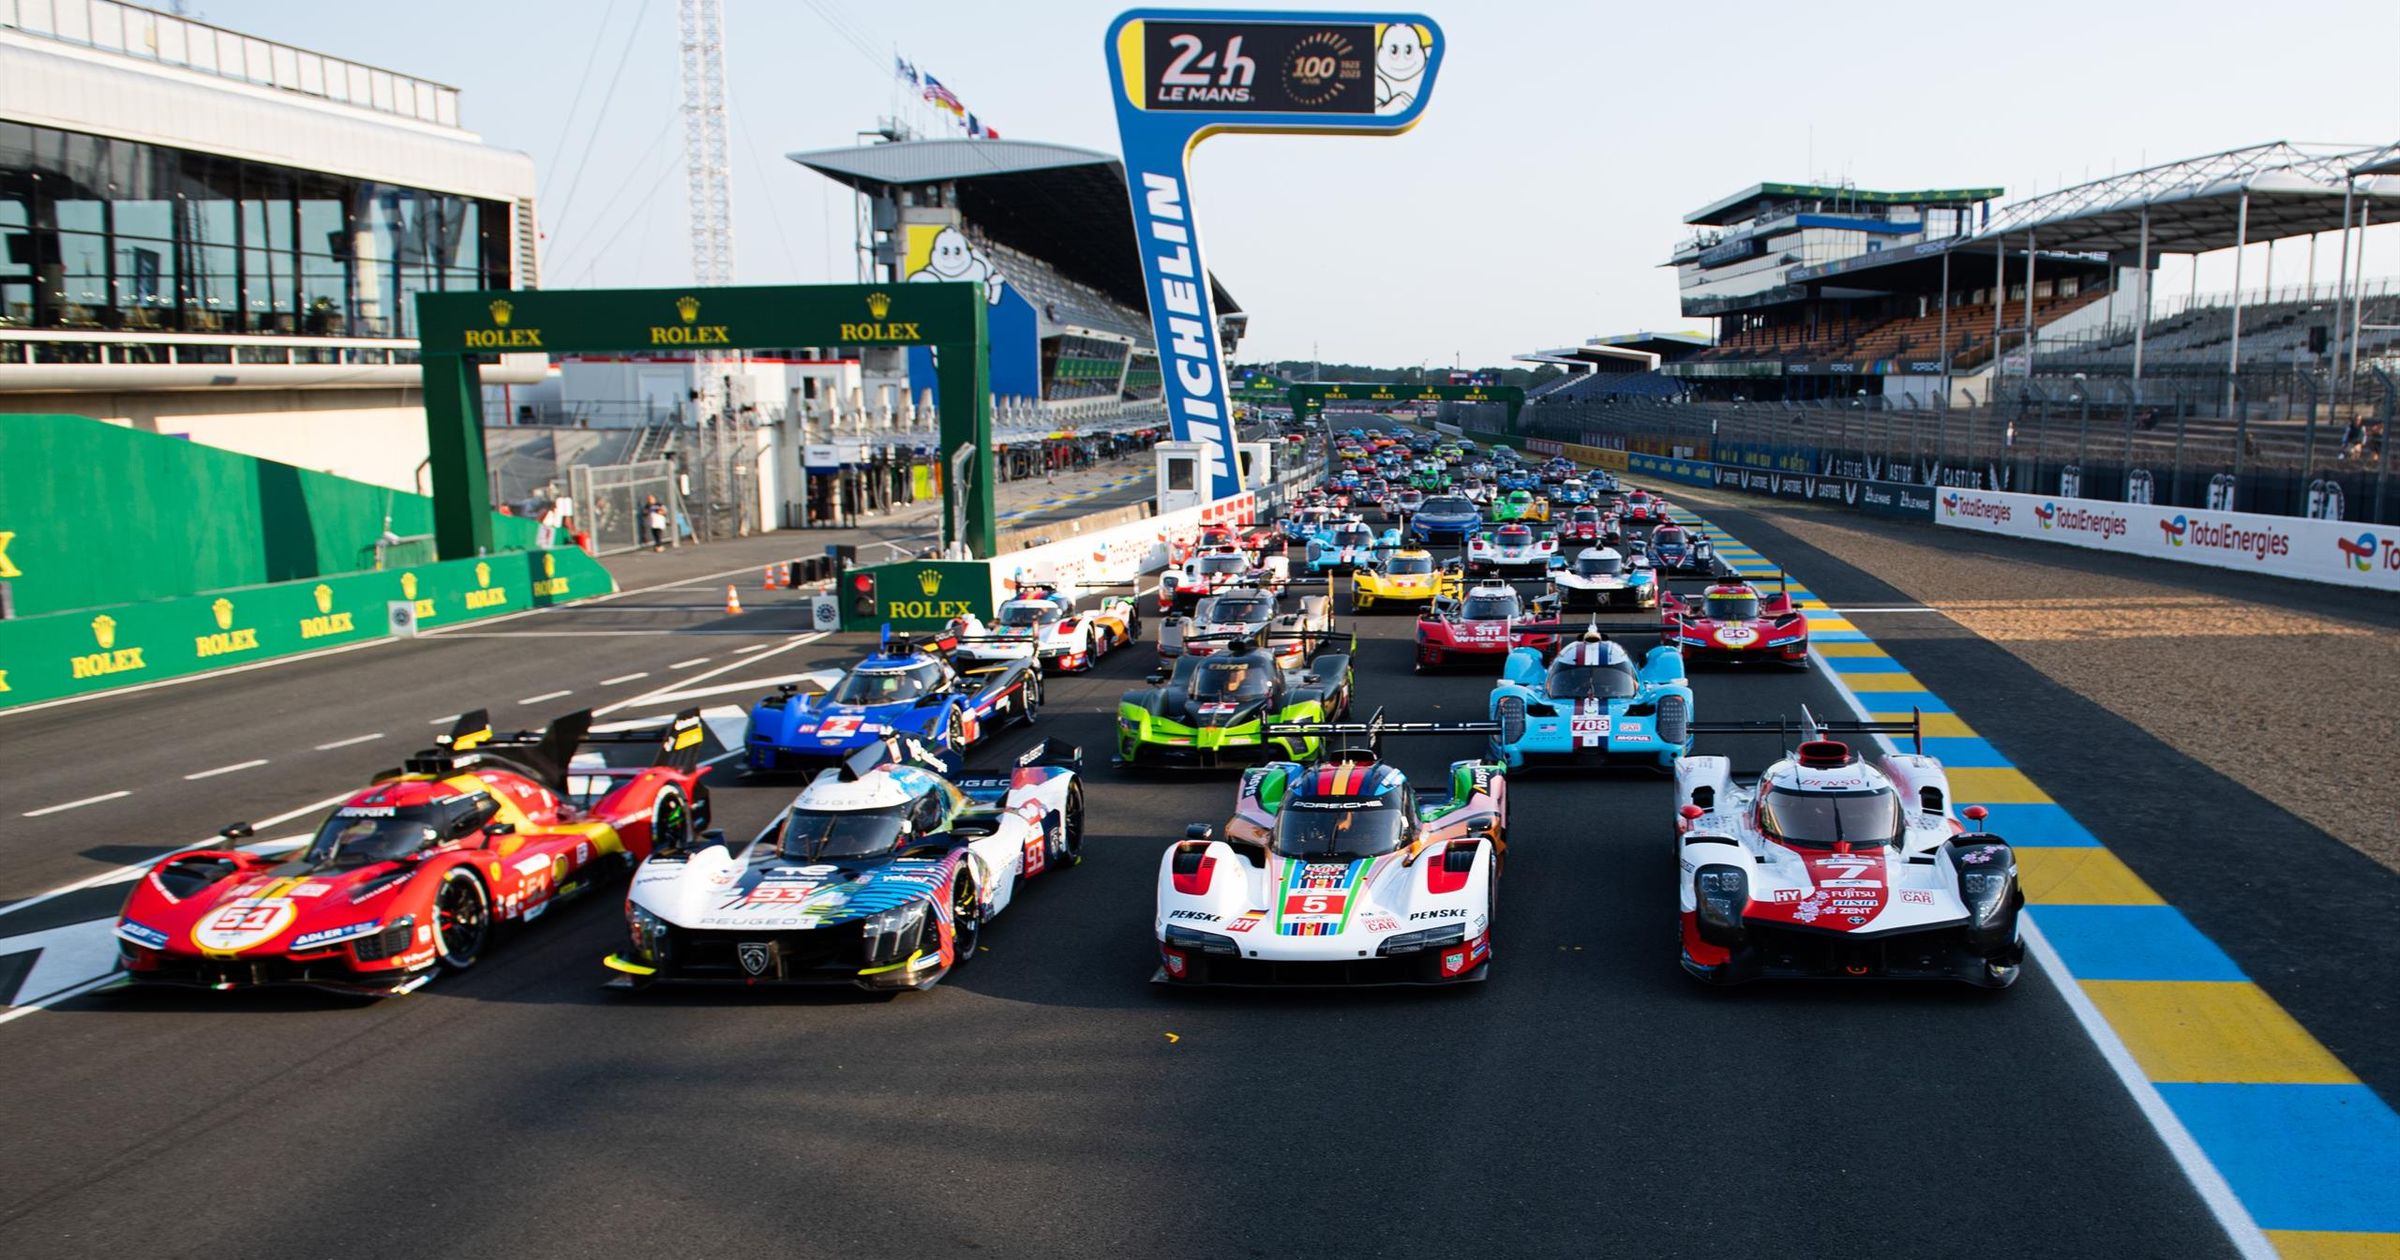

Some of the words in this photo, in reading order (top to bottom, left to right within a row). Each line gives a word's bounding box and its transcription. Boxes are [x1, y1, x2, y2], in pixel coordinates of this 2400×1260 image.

[1161, 34, 1256, 86] 24h
[1292, 56, 1335, 78] 100
[1158, 87, 1184, 101] LE
[1188, 87, 1250, 103] MANS
[841, 323, 920, 341] ROLEX
[1142, 172, 1228, 477] MICHELIN
[465, 329, 542, 348] ROLEX
[651, 326, 730, 344] ROLEX
[1959, 496, 2012, 525] TotalEnergies
[2056, 506, 2127, 539] TotalEnergies
[2190, 519, 2290, 560] TotalEnergies
[533, 577, 570, 597] ROLEX
[465, 587, 507, 609] ROLEX
[889, 601, 972, 619] ROLEX
[300, 612, 354, 639] ROLEX
[1724, 629, 1748, 637] 50
[195, 629, 259, 657] ROLEX
[71, 647, 146, 678] ROLEX
[834, 721, 852, 731] 2
[1574, 720, 1609, 731] 708
[1292, 800, 1384, 810] PORSCHE
[1826, 866, 1868, 878] 7
[750, 888, 805, 902] 93
[1776, 891, 1800, 901] HY
[1832, 889, 1876, 899] FUJITSU
[1903, 894, 1931, 903] CAR
[1302, 896, 1328, 912] 5
[216, 908, 276, 929] 51
[1169, 910, 1223, 922] PENSKE
[1410, 909, 1468, 920] PENSKE
[1230, 919, 1257, 931] HY
[1368, 921, 1399, 931] CAR
[296, 928, 343, 944] ADLER
